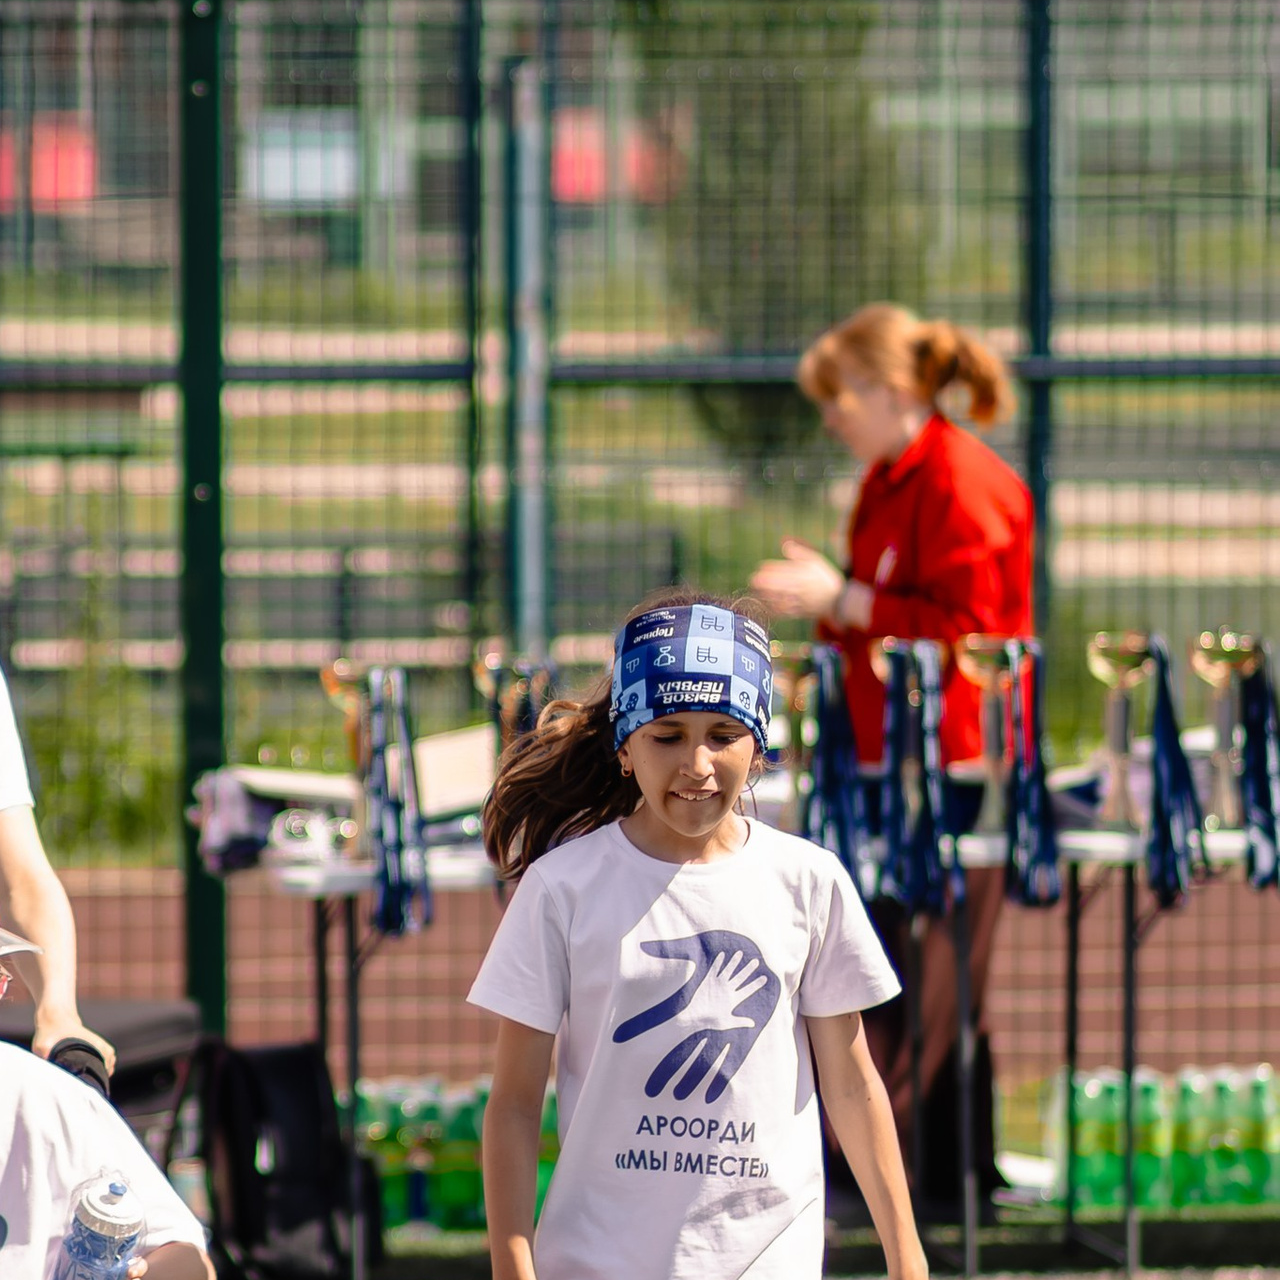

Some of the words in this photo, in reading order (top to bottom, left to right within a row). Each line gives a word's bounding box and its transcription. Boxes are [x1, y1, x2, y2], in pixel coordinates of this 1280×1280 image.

[657, 681, 724, 694] ПЕРВЫХ
[662, 693, 721, 704] ВЫЗОВ
[635, 1115, 756, 1144] АРООРДИ
[615, 1149, 668, 1171] «МЫ
[674, 1152, 770, 1178] ВМЕСТЕ»
